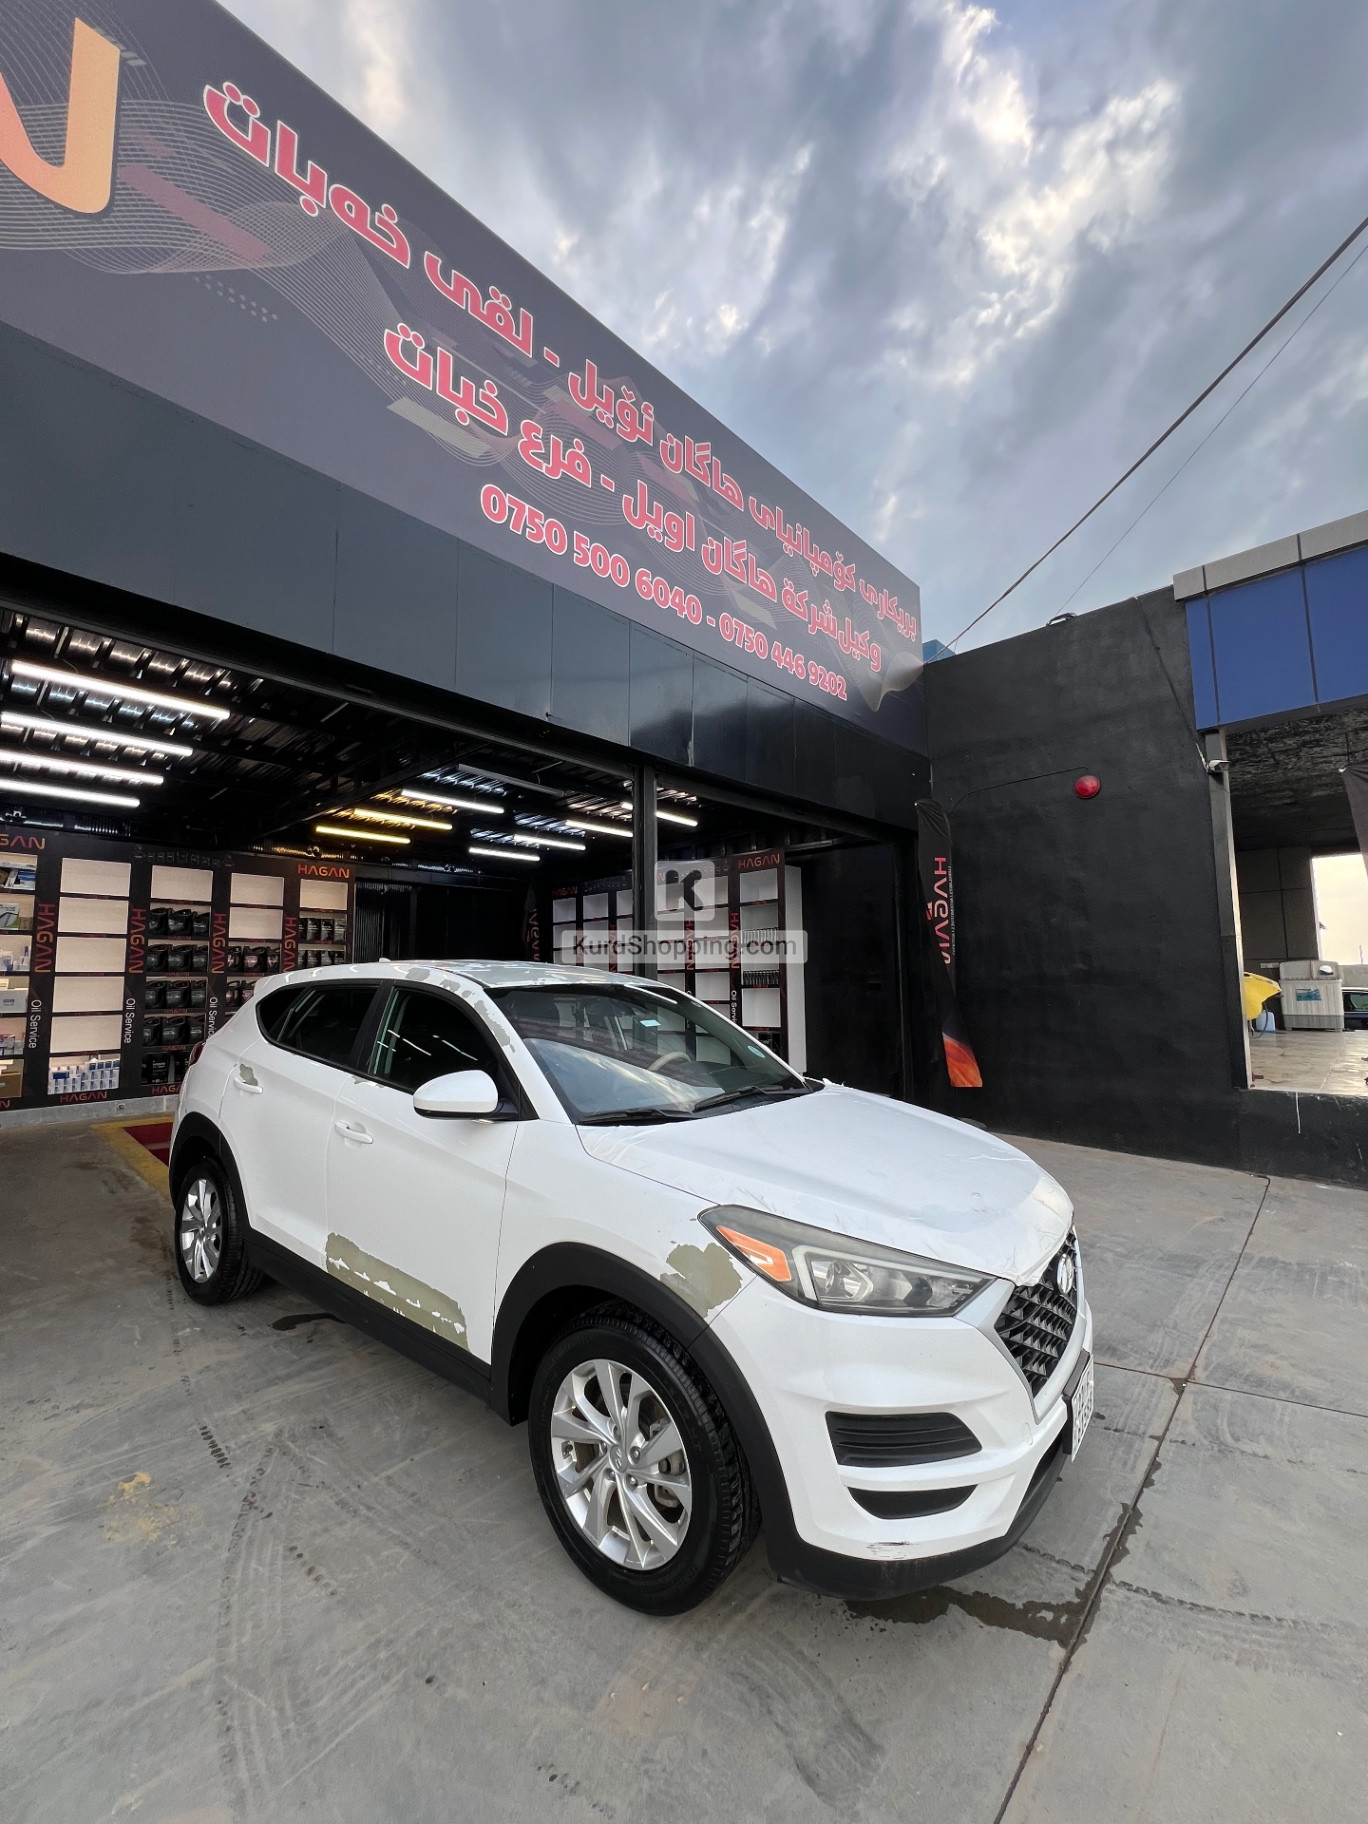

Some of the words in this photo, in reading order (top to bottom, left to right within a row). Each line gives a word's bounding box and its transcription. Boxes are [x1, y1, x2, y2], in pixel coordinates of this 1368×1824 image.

[384, 323, 508, 435] خبات
[518, 419, 592, 488] فرع
[660, 433, 744, 512] هاگان
[701, 536, 777, 602] هاگان
[480, 484, 568, 555] 0750
[573, 531, 631, 588] 500
[635, 568, 702, 625] 6040
[719, 612, 768, 659] 0750
[771, 641, 806, 680] 446
[808, 660, 847, 701] 9202
[297, 864, 350, 878] HAGAN
[738, 853, 780, 869] HAGAN
[34, 903, 55, 973] HAGAN
[128, 908, 147, 974] HAGAN
[211, 913, 227, 974] HAGAN
[283, 917, 297, 973] HAGAN
[31, 999, 42, 1012] Oil
[125, 998, 136, 1010] Oil
[207, 1010, 217, 1038] Servic
[209, 996, 218, 1009] Oil
[28, 1014, 41, 1049] Service
[123, 1012, 135, 1044] Service
[60, 1091, 108, 1102] HAGAN
